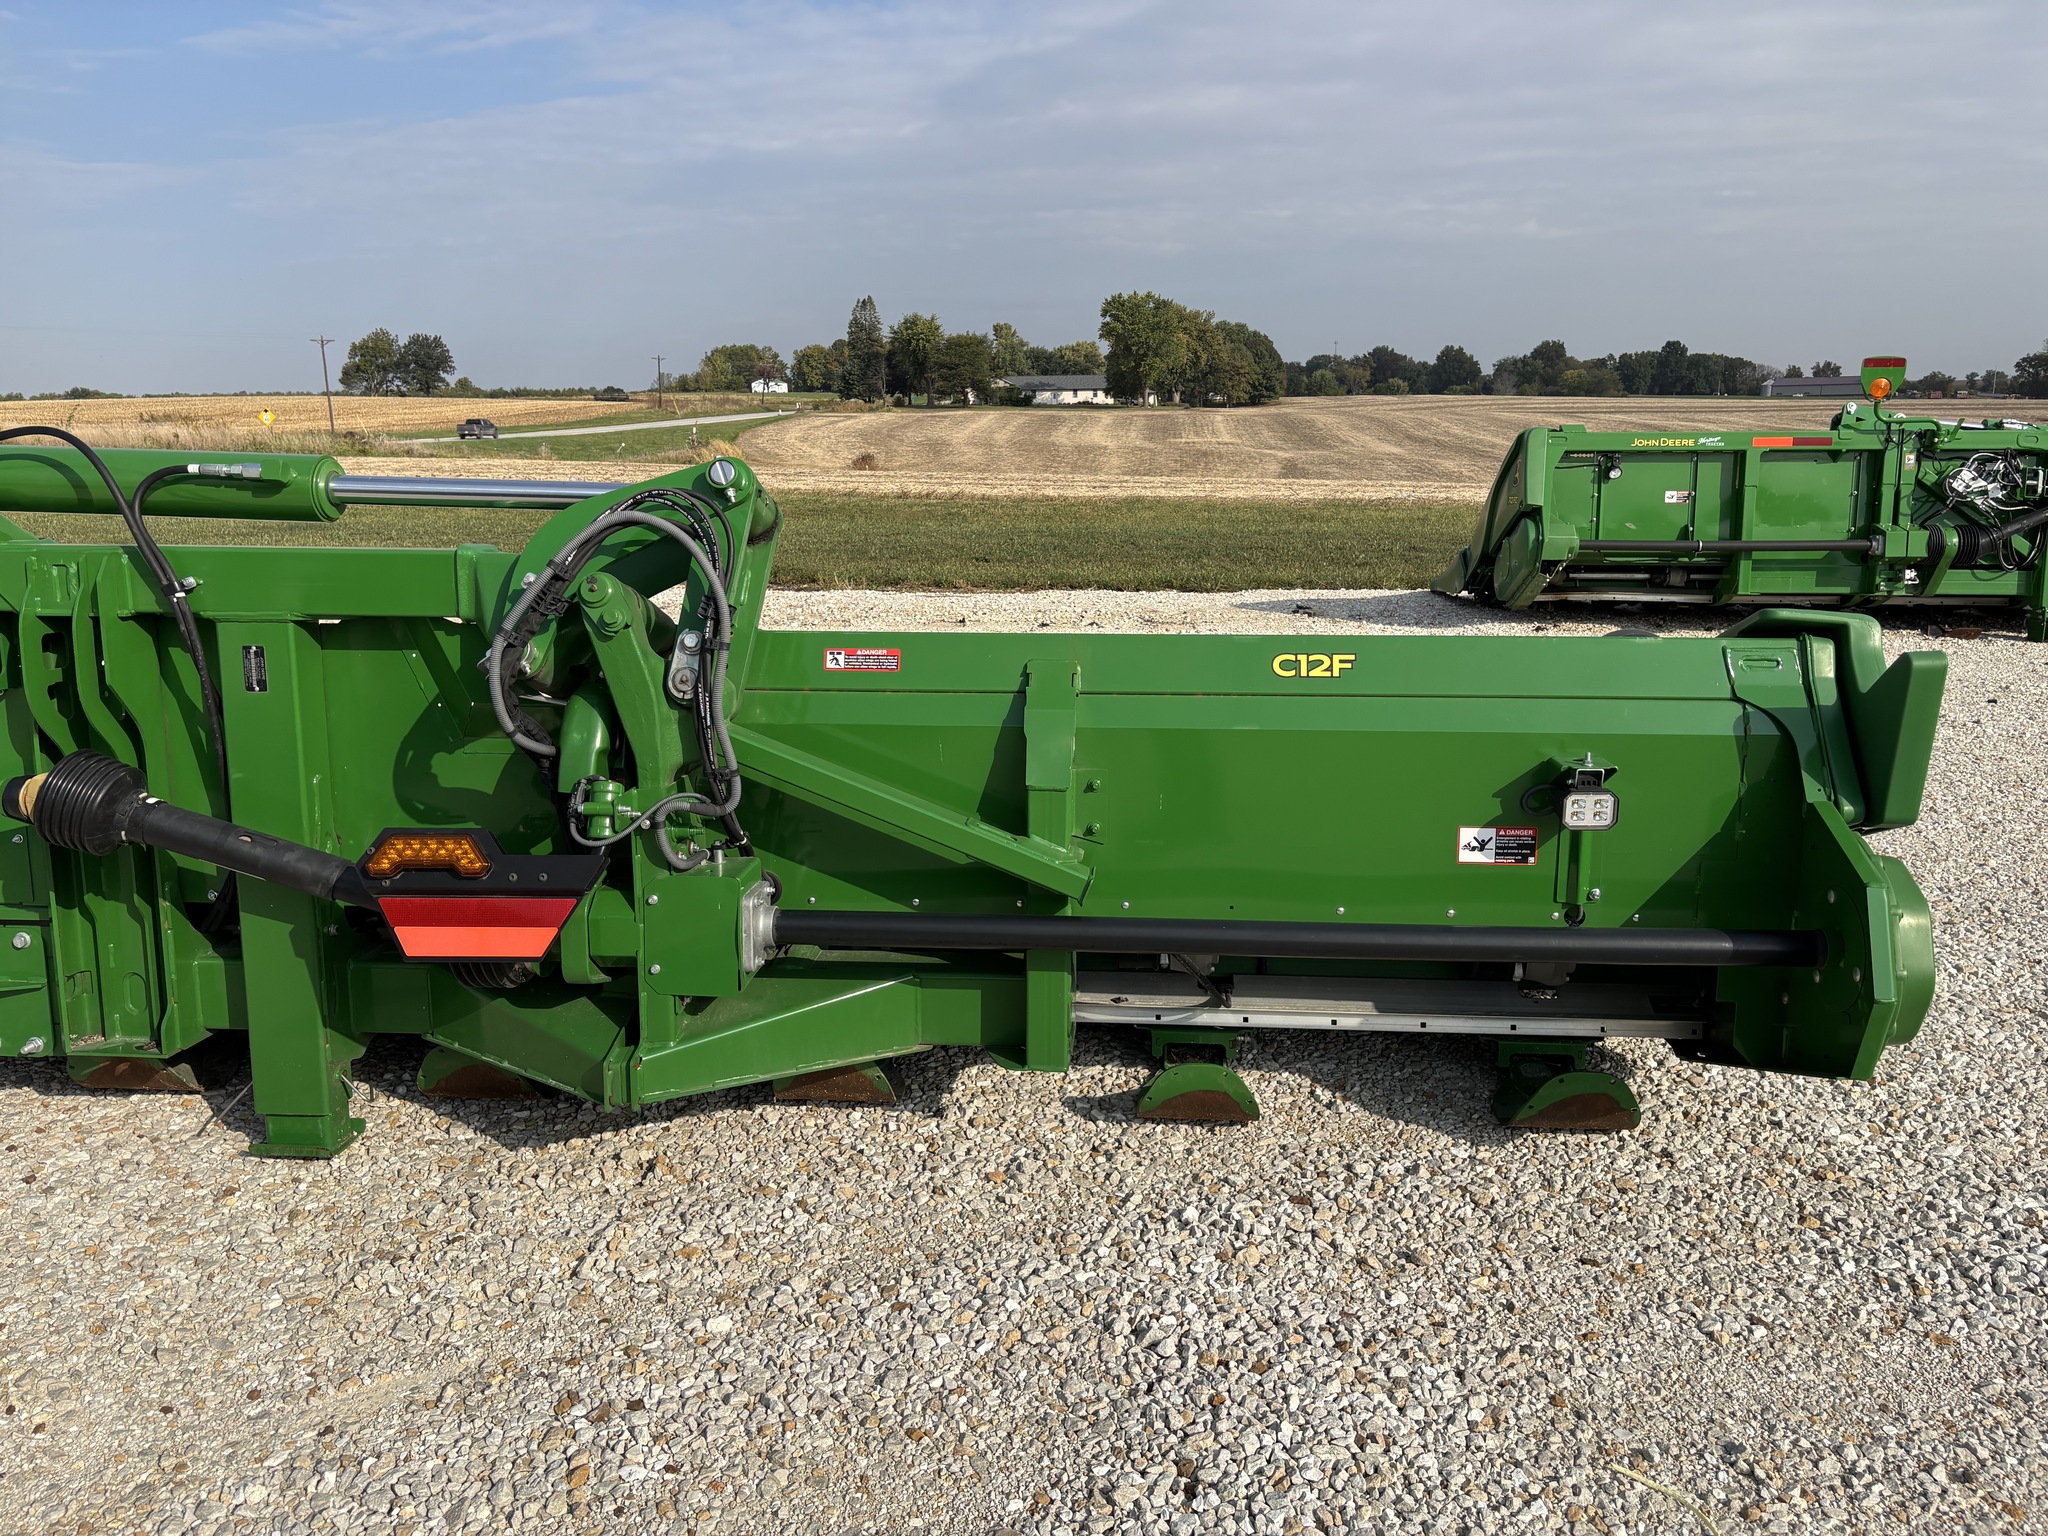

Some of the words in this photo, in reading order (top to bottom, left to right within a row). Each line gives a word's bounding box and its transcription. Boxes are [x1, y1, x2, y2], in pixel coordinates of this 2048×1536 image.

[1631, 438, 1659, 447] JOHN
[1660, 438, 1695, 447] DEERE
[1271, 653, 1357, 678] C12F
